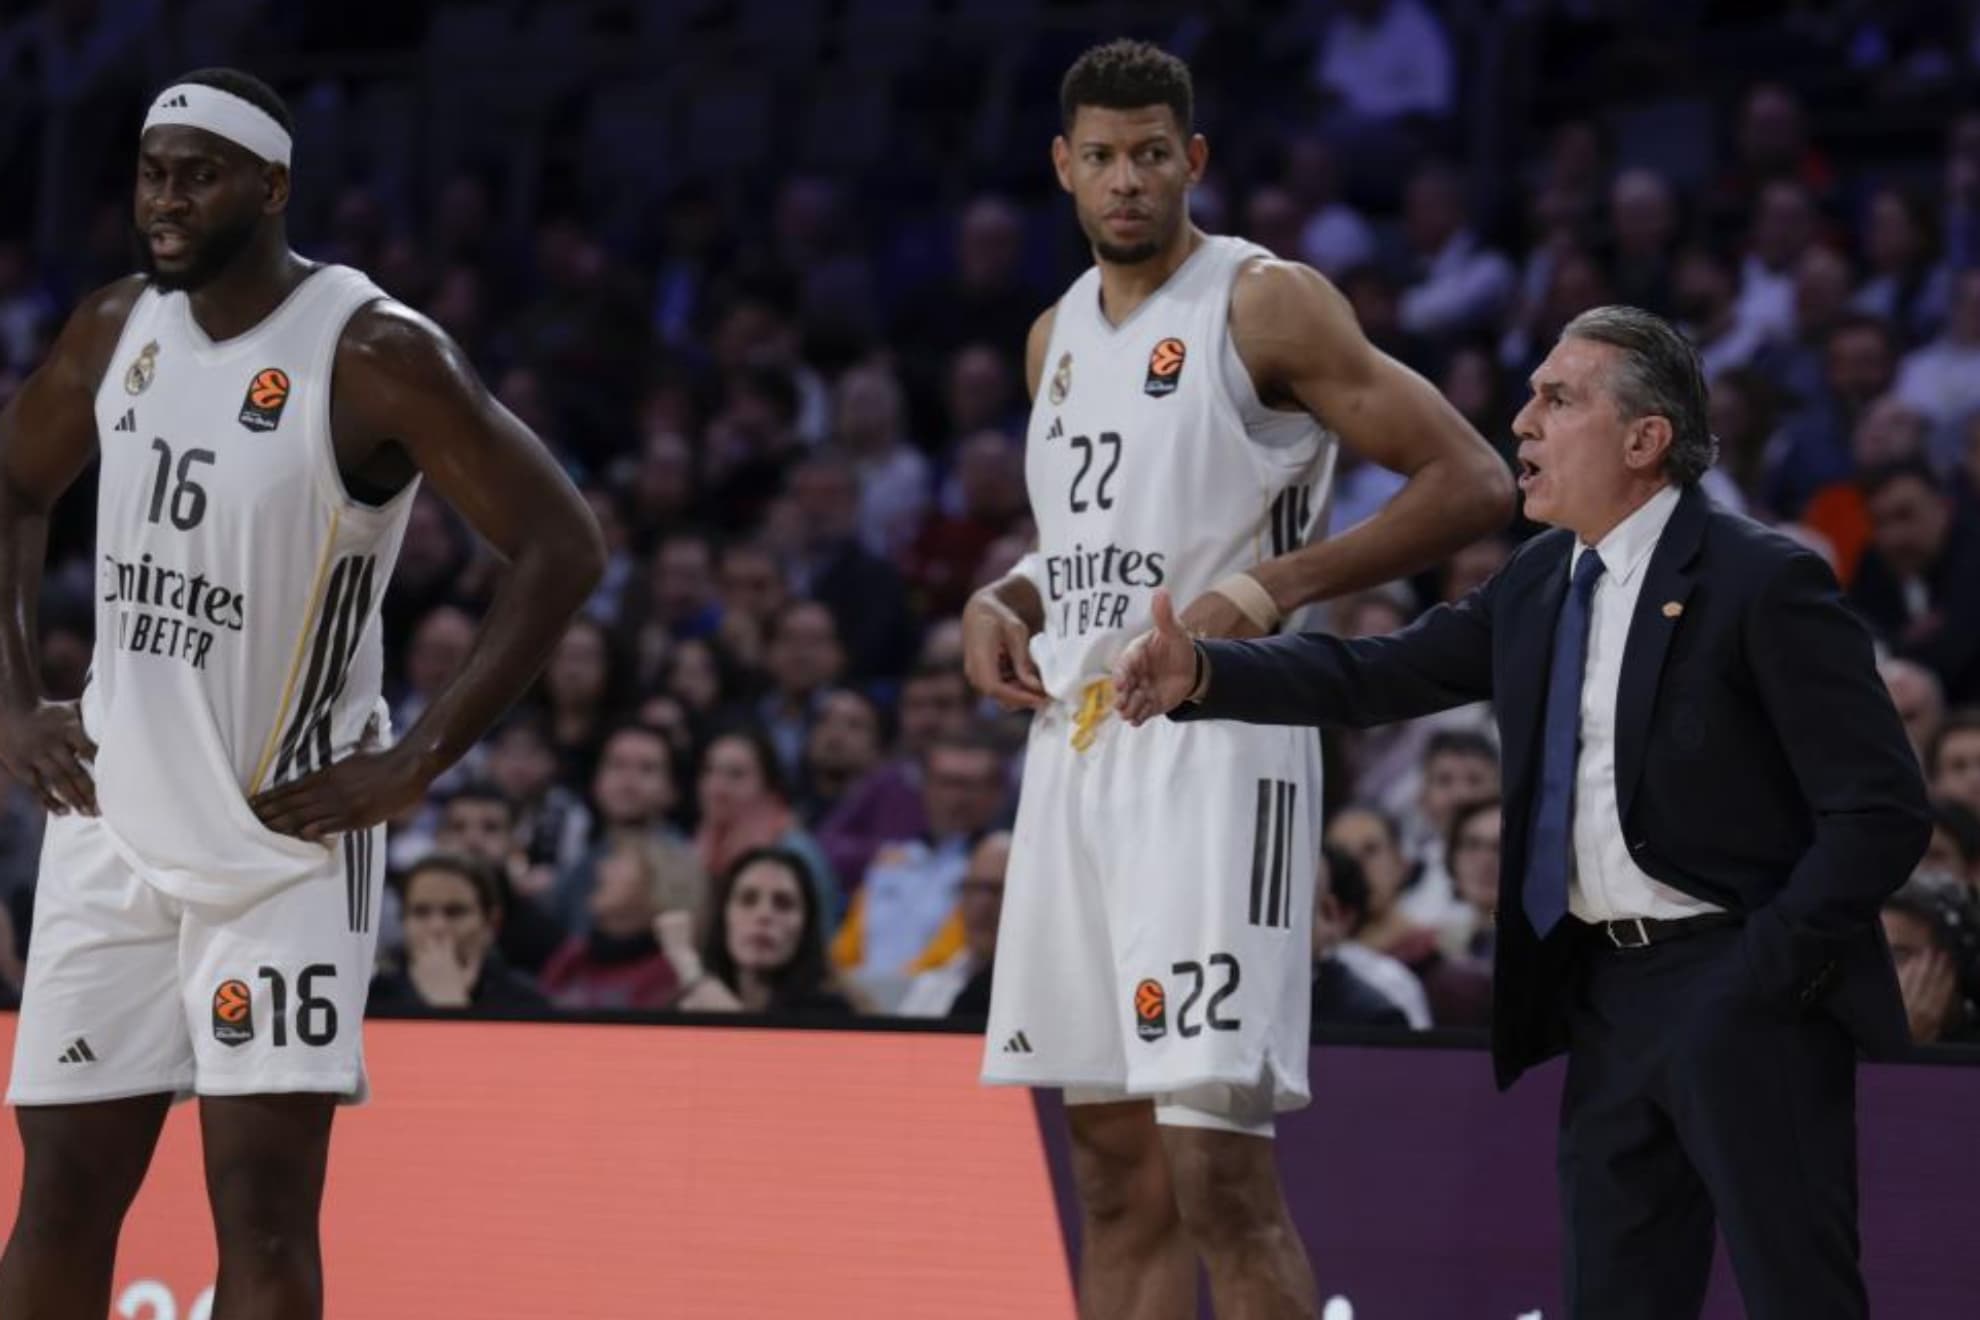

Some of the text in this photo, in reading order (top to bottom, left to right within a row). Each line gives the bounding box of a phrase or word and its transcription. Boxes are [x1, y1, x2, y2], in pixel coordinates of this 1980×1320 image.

[148, 437, 216, 531] 16
[1069, 431, 1122, 513] 22
[1046, 542, 1165, 602] Eirtes
[130, 612, 214, 670] BETER
[258, 963, 338, 1047] 16
[1171, 953, 1241, 1038] 22
